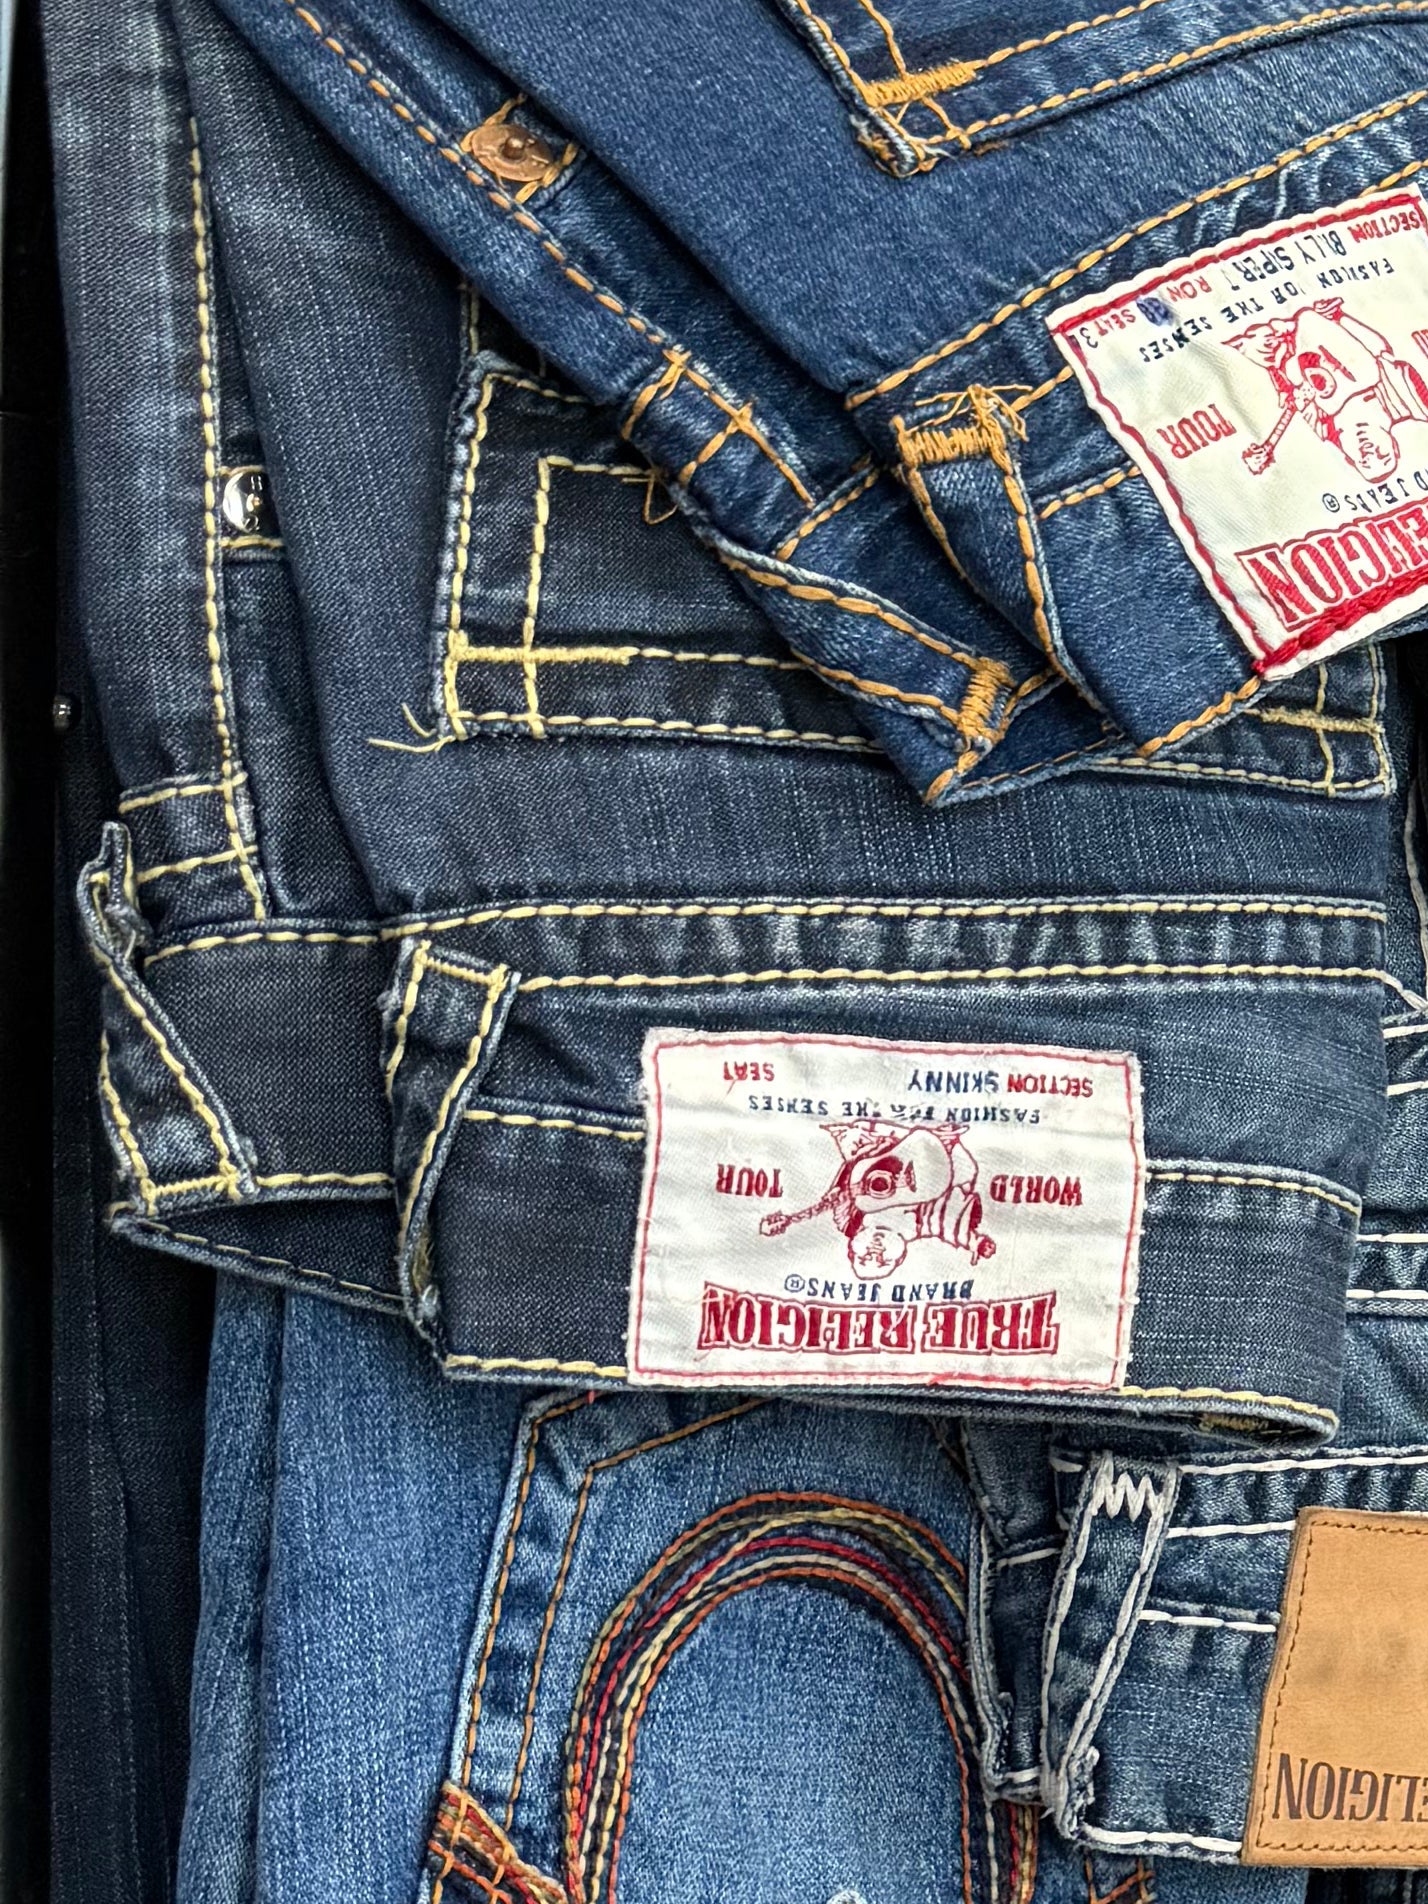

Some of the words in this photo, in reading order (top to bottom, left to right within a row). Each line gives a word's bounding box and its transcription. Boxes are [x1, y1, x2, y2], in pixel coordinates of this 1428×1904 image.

[1346, 209, 1421, 245] SECTION
[1165, 274, 1212, 302] ROW
[1092, 307, 1136, 337] SEAT
[1221, 296, 1263, 324] THE
[1138, 315, 1213, 363] SENSES
[1156, 403, 1236, 459] TOUR
[721, 1060, 774, 1082] SEAT
[906, 1068, 1000, 1094] SKINNY
[1006, 1072, 1093, 1097] SECTION
[747, 1094, 828, 1115] SENSES
[841, 1099, 880, 1118] THE
[890, 1102, 934, 1120] FOR
[945, 1105, 1040, 1124] FASHION
[714, 1162, 783, 1198] TOUR
[988, 1173, 1083, 1206] WORLD
[890, 1278, 973, 1304] BRAND
[699, 1284, 915, 1355] RELIGION
[923, 1290, 1055, 1352] TRUE
